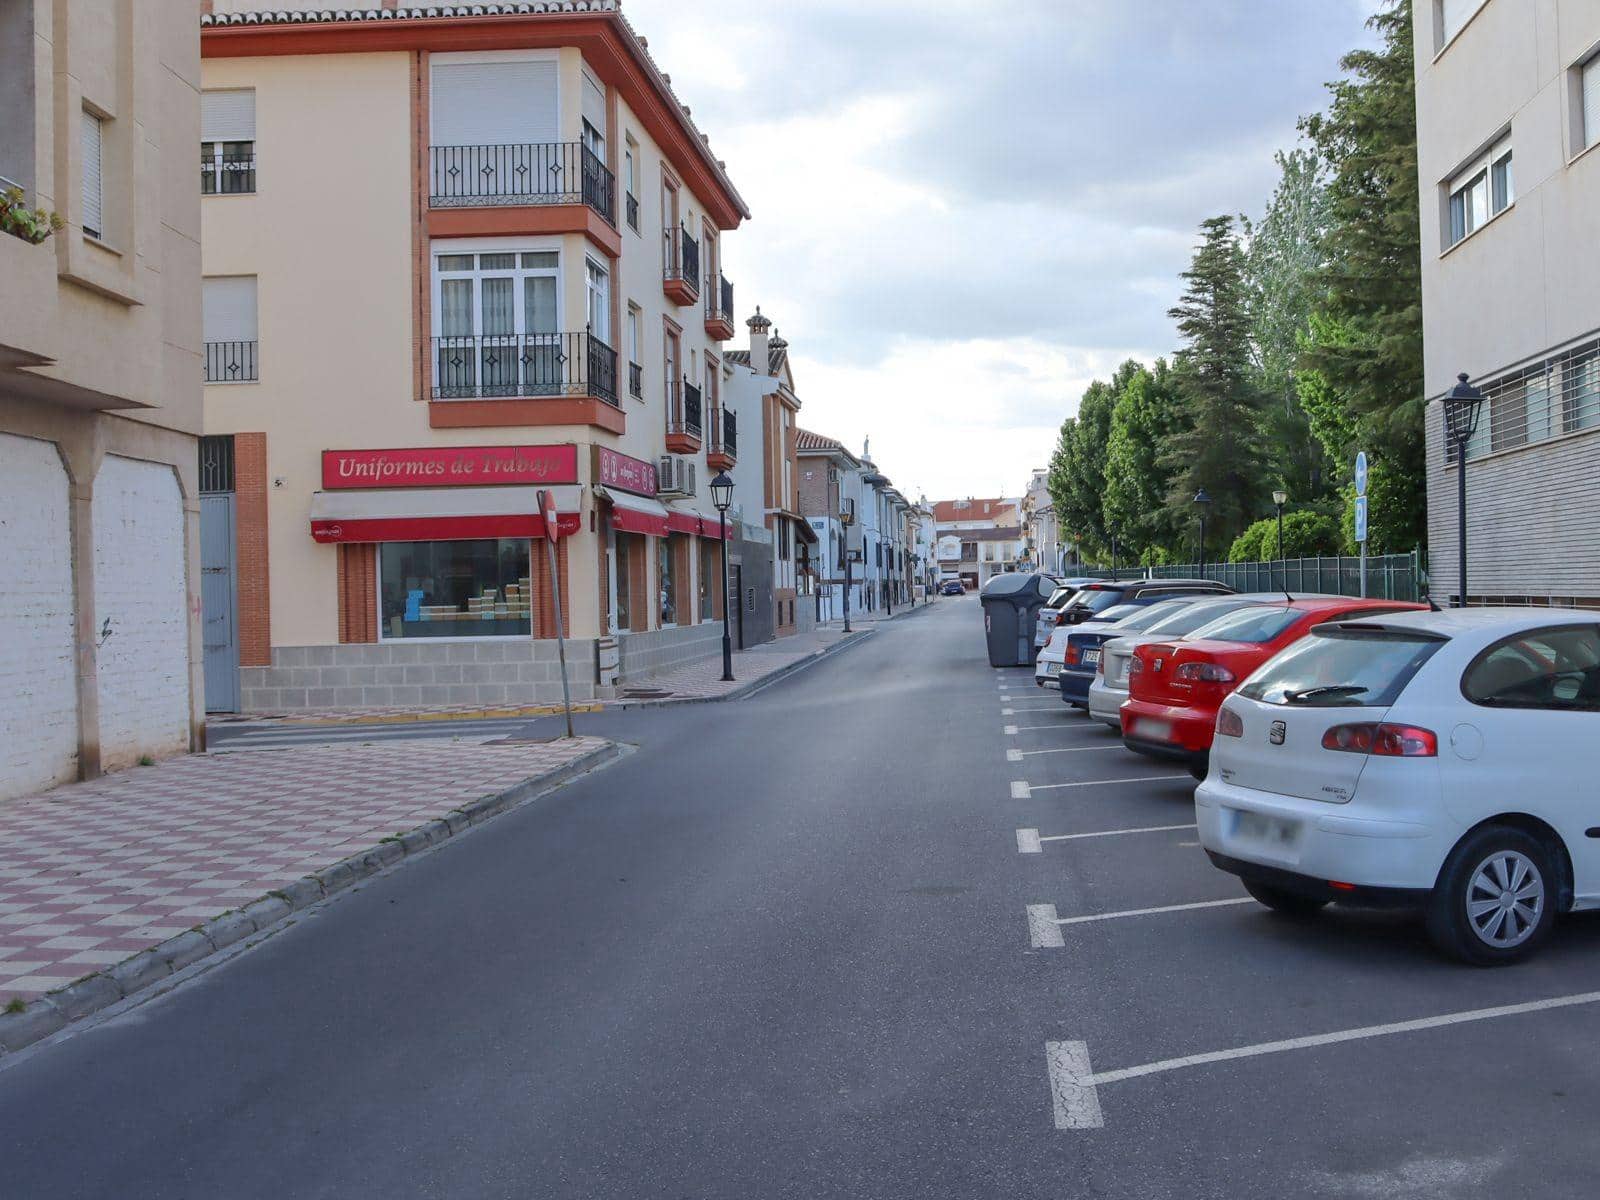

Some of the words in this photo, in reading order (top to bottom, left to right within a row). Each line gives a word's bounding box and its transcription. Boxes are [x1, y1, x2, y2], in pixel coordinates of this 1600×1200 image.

[338, 456, 445, 480] Uniformes
[451, 454, 474, 474] de
[481, 453, 562, 477] Trabajo
